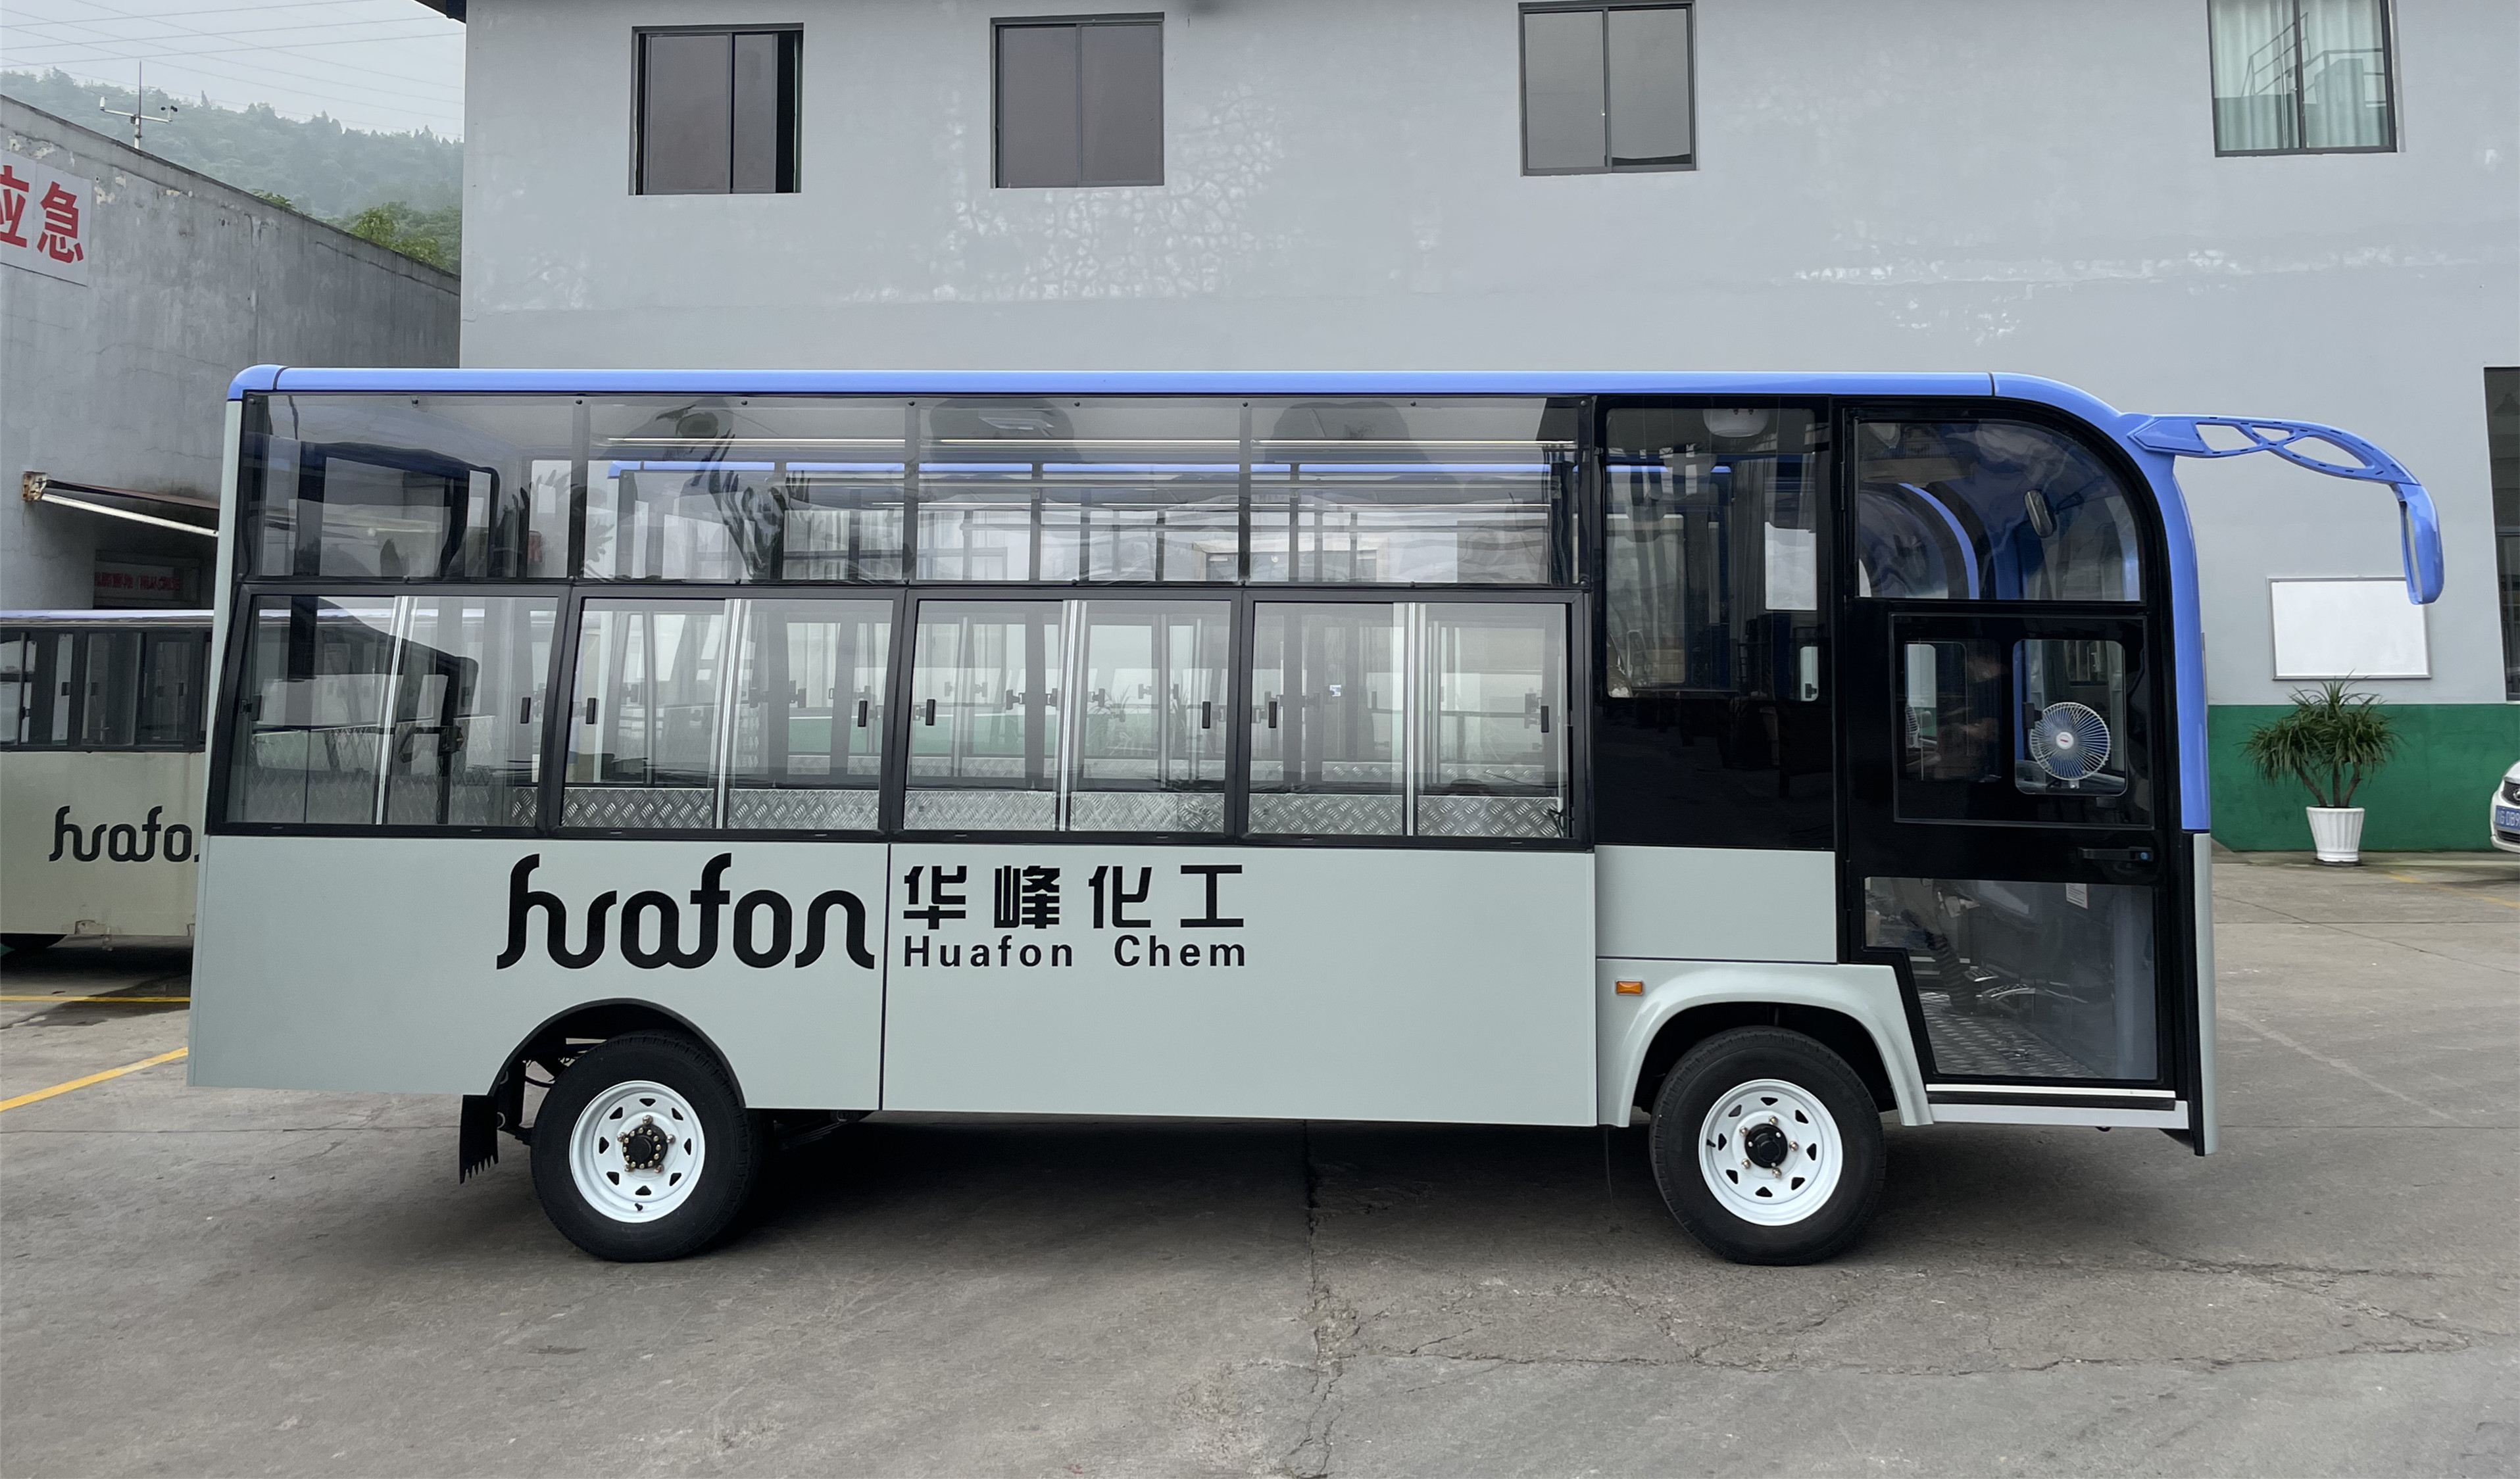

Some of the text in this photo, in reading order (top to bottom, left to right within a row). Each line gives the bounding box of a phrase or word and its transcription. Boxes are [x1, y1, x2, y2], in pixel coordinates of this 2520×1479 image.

[0, 165, 84, 264] 应急
[49, 806, 199, 862] huafo
[903, 864, 1245, 930] 华峰化工
[904, 934, 1245, 967] Huafon Chem
